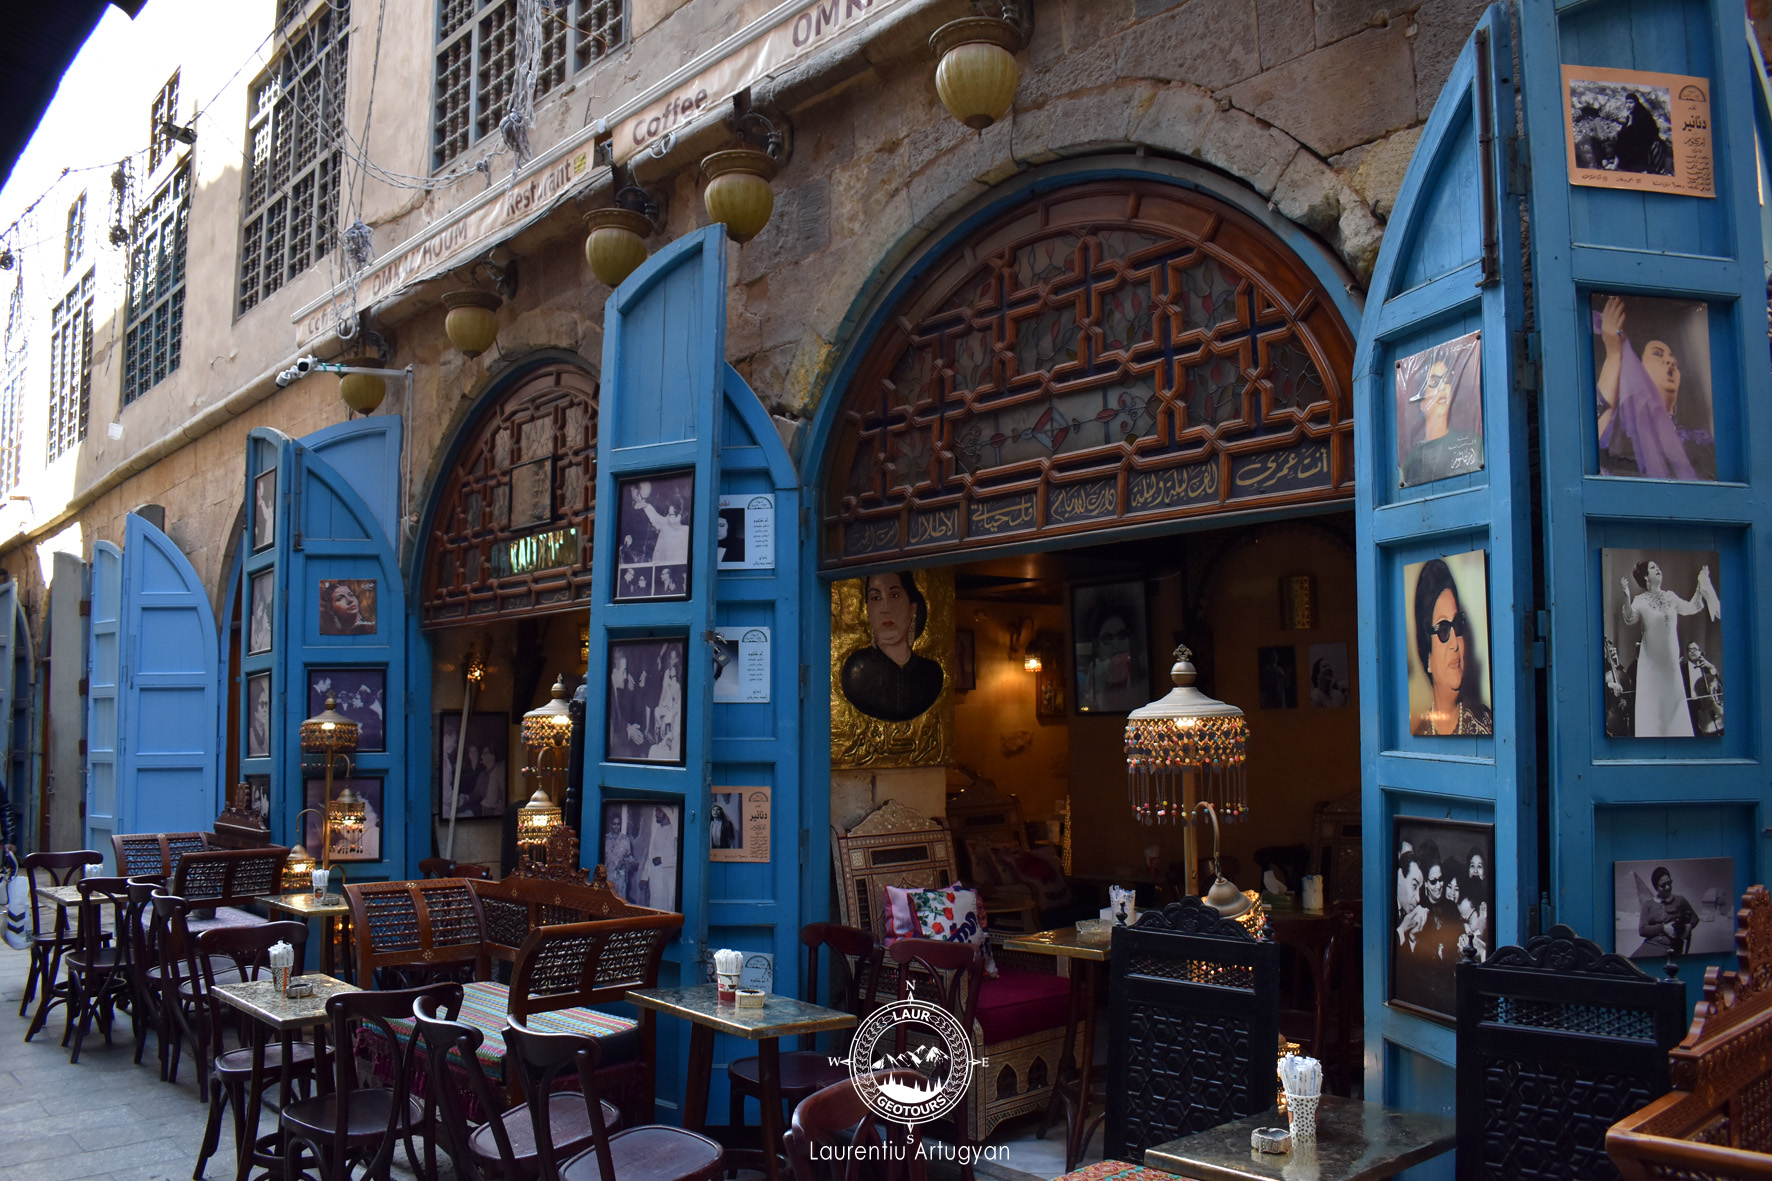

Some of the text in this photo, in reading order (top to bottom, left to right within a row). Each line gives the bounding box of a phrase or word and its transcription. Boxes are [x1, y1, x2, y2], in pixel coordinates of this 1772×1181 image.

[632, 0, 873, 146] Coffee OMK
[1682, 114, 1706, 132] دنانير
[506, 158, 571, 217] Resturant
